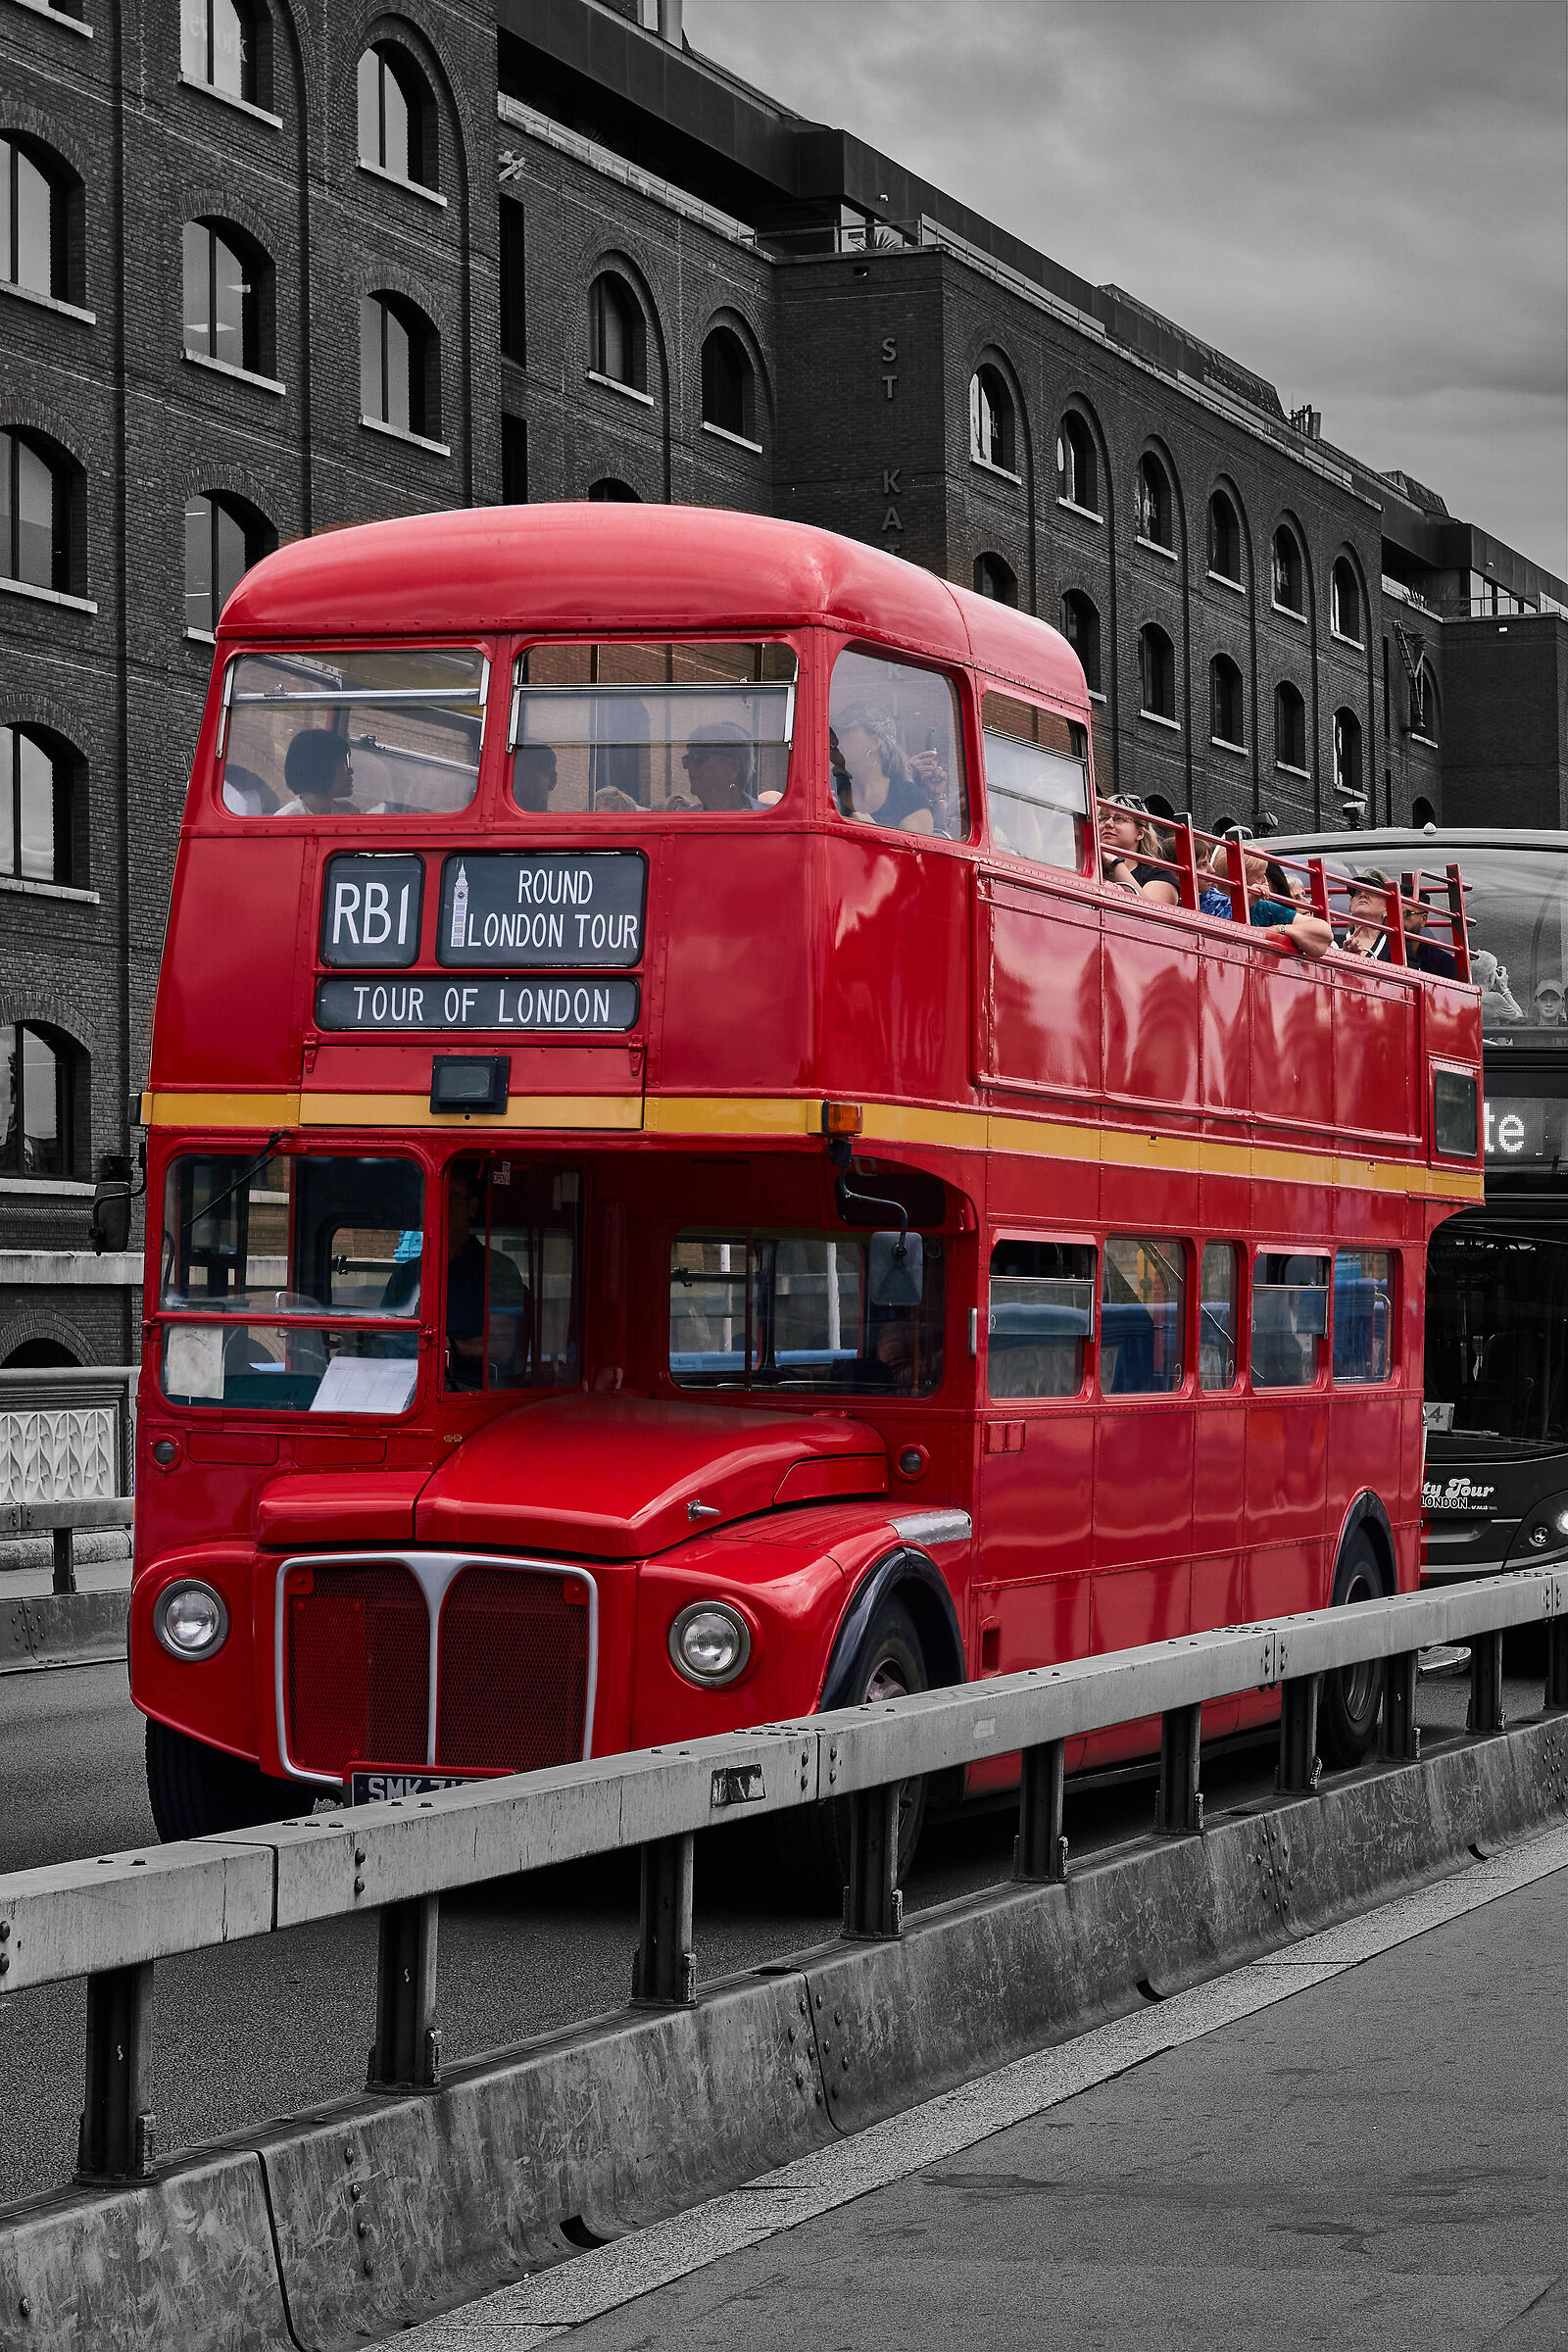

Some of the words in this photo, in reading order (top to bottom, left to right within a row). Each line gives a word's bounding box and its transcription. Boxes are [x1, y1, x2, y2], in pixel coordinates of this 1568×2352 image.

[882, 337, 898, 399] ST
[517, 869, 593, 905] ROUND
[332, 883, 410, 945] RB1
[467, 912, 564, 948] LONDON
[574, 913, 638, 949] TOUR
[354, 986, 424, 1021] TOUR
[444, 987, 478, 1022] OF
[498, 988, 610, 1023] LONDON
[1483, 1102, 1525, 1152] te
[1421, 1494, 1468, 1509] LONDON
[1445, 1478, 1494, 1499] Tour
[368, 1777, 422, 1803] SMK
